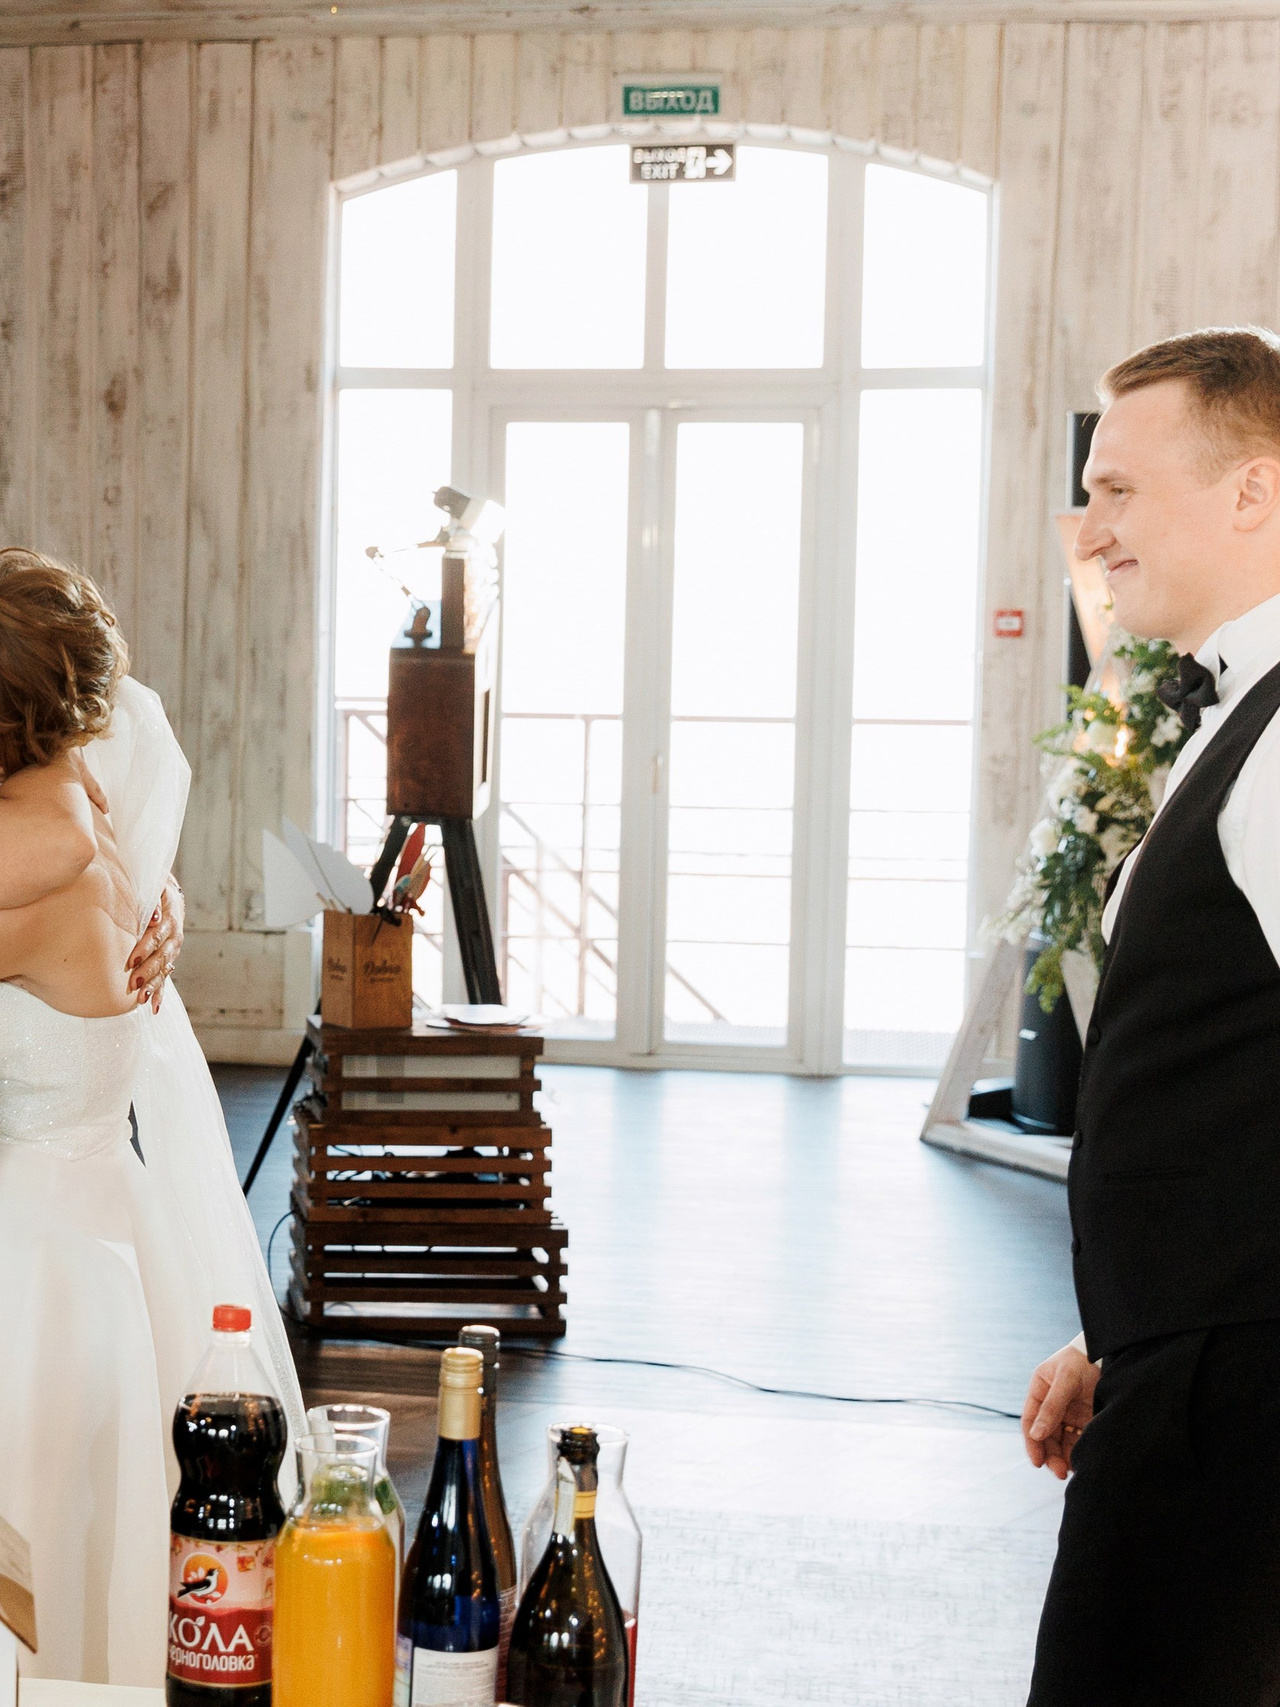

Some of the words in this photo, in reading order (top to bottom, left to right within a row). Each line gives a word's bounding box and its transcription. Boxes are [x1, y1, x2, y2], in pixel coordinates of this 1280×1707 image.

[629, 90, 715, 112] ВЫХОД
[641, 163, 679, 179] EXIT
[169, 1611, 254, 1652] КОЛА
